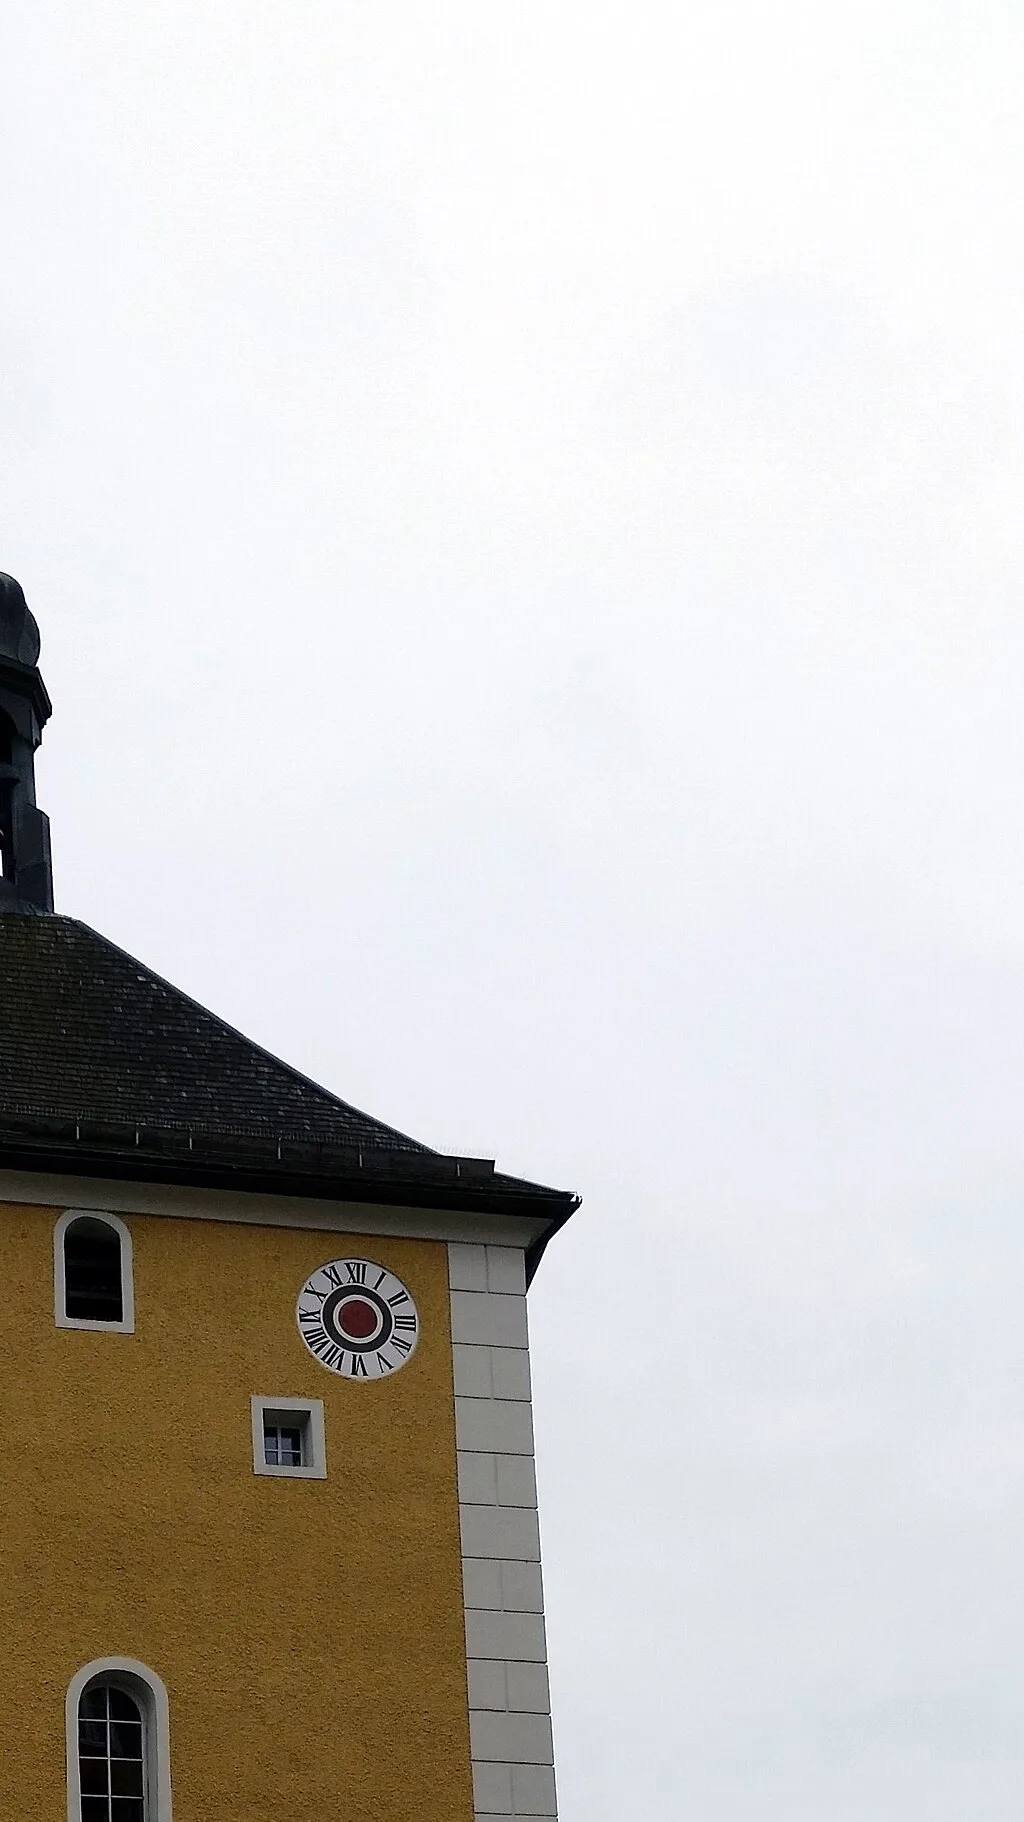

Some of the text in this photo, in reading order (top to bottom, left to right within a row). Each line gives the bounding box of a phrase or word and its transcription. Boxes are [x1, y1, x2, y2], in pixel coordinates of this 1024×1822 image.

[321, 1265, 343, 1290] XI
[344, 1262, 367, 1285] XII
[373, 1271, 387, 1290] I
[304, 1281, 328, 1304] X
[387, 1290, 409, 1308] II
[298, 1306, 322, 1324] IX
[394, 1314, 416, 1332] III
[303, 1326, 330, 1355] VIII
[389, 1334, 413, 1358] IV
[321, 1344, 344, 1371] VII
[351, 1354, 368, 1377] VI
[377, 1351, 394, 1374] V
